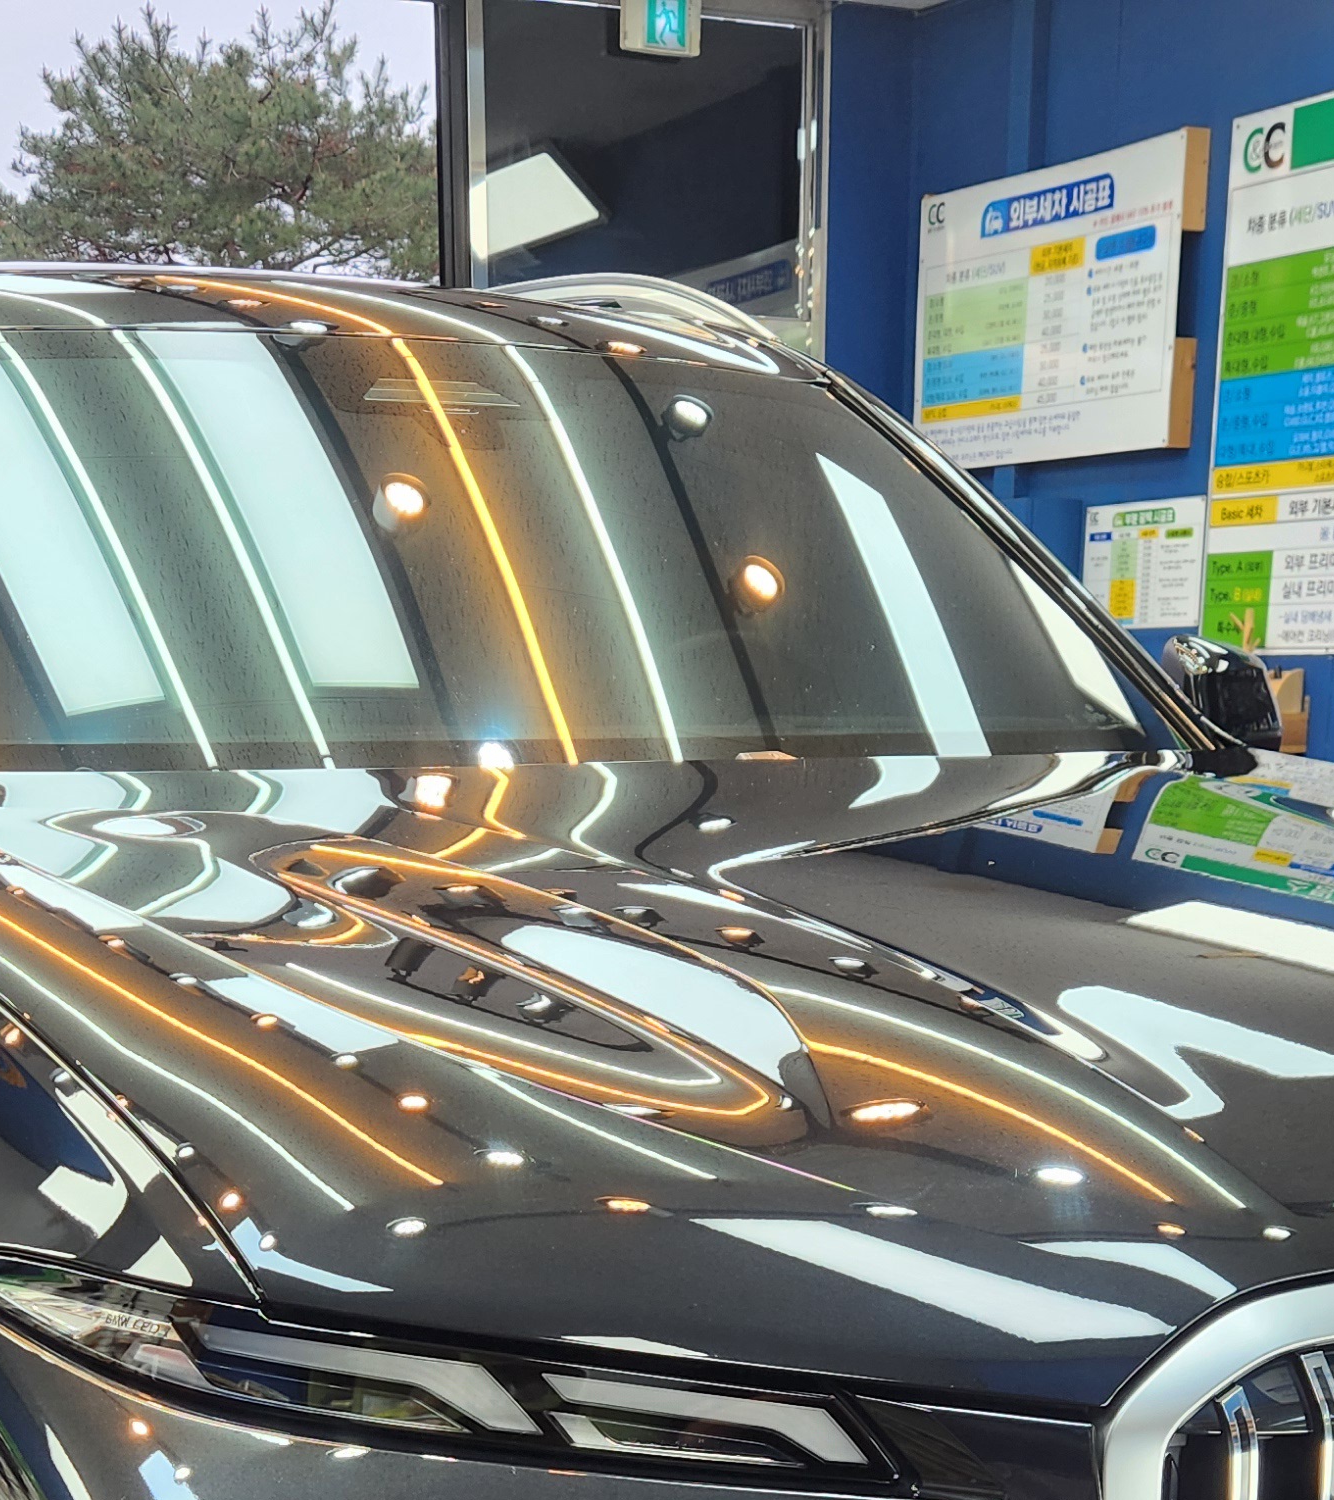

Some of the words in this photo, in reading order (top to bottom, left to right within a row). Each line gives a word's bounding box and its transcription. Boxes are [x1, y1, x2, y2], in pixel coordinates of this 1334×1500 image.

[1008, 187, 1067, 231] 외부세차
[1070, 175, 1112, 214] 시공표
[1246, 214, 1264, 237] 차종
[1267, 209, 1287, 231] 분류
[1220, 506, 1244, 521] Basic
[1246, 504, 1263, 518] 세차
[1288, 500, 1308, 515] 외부
[1284, 554, 1304, 570] 외부
[1282, 582, 1302, 598] 실내
